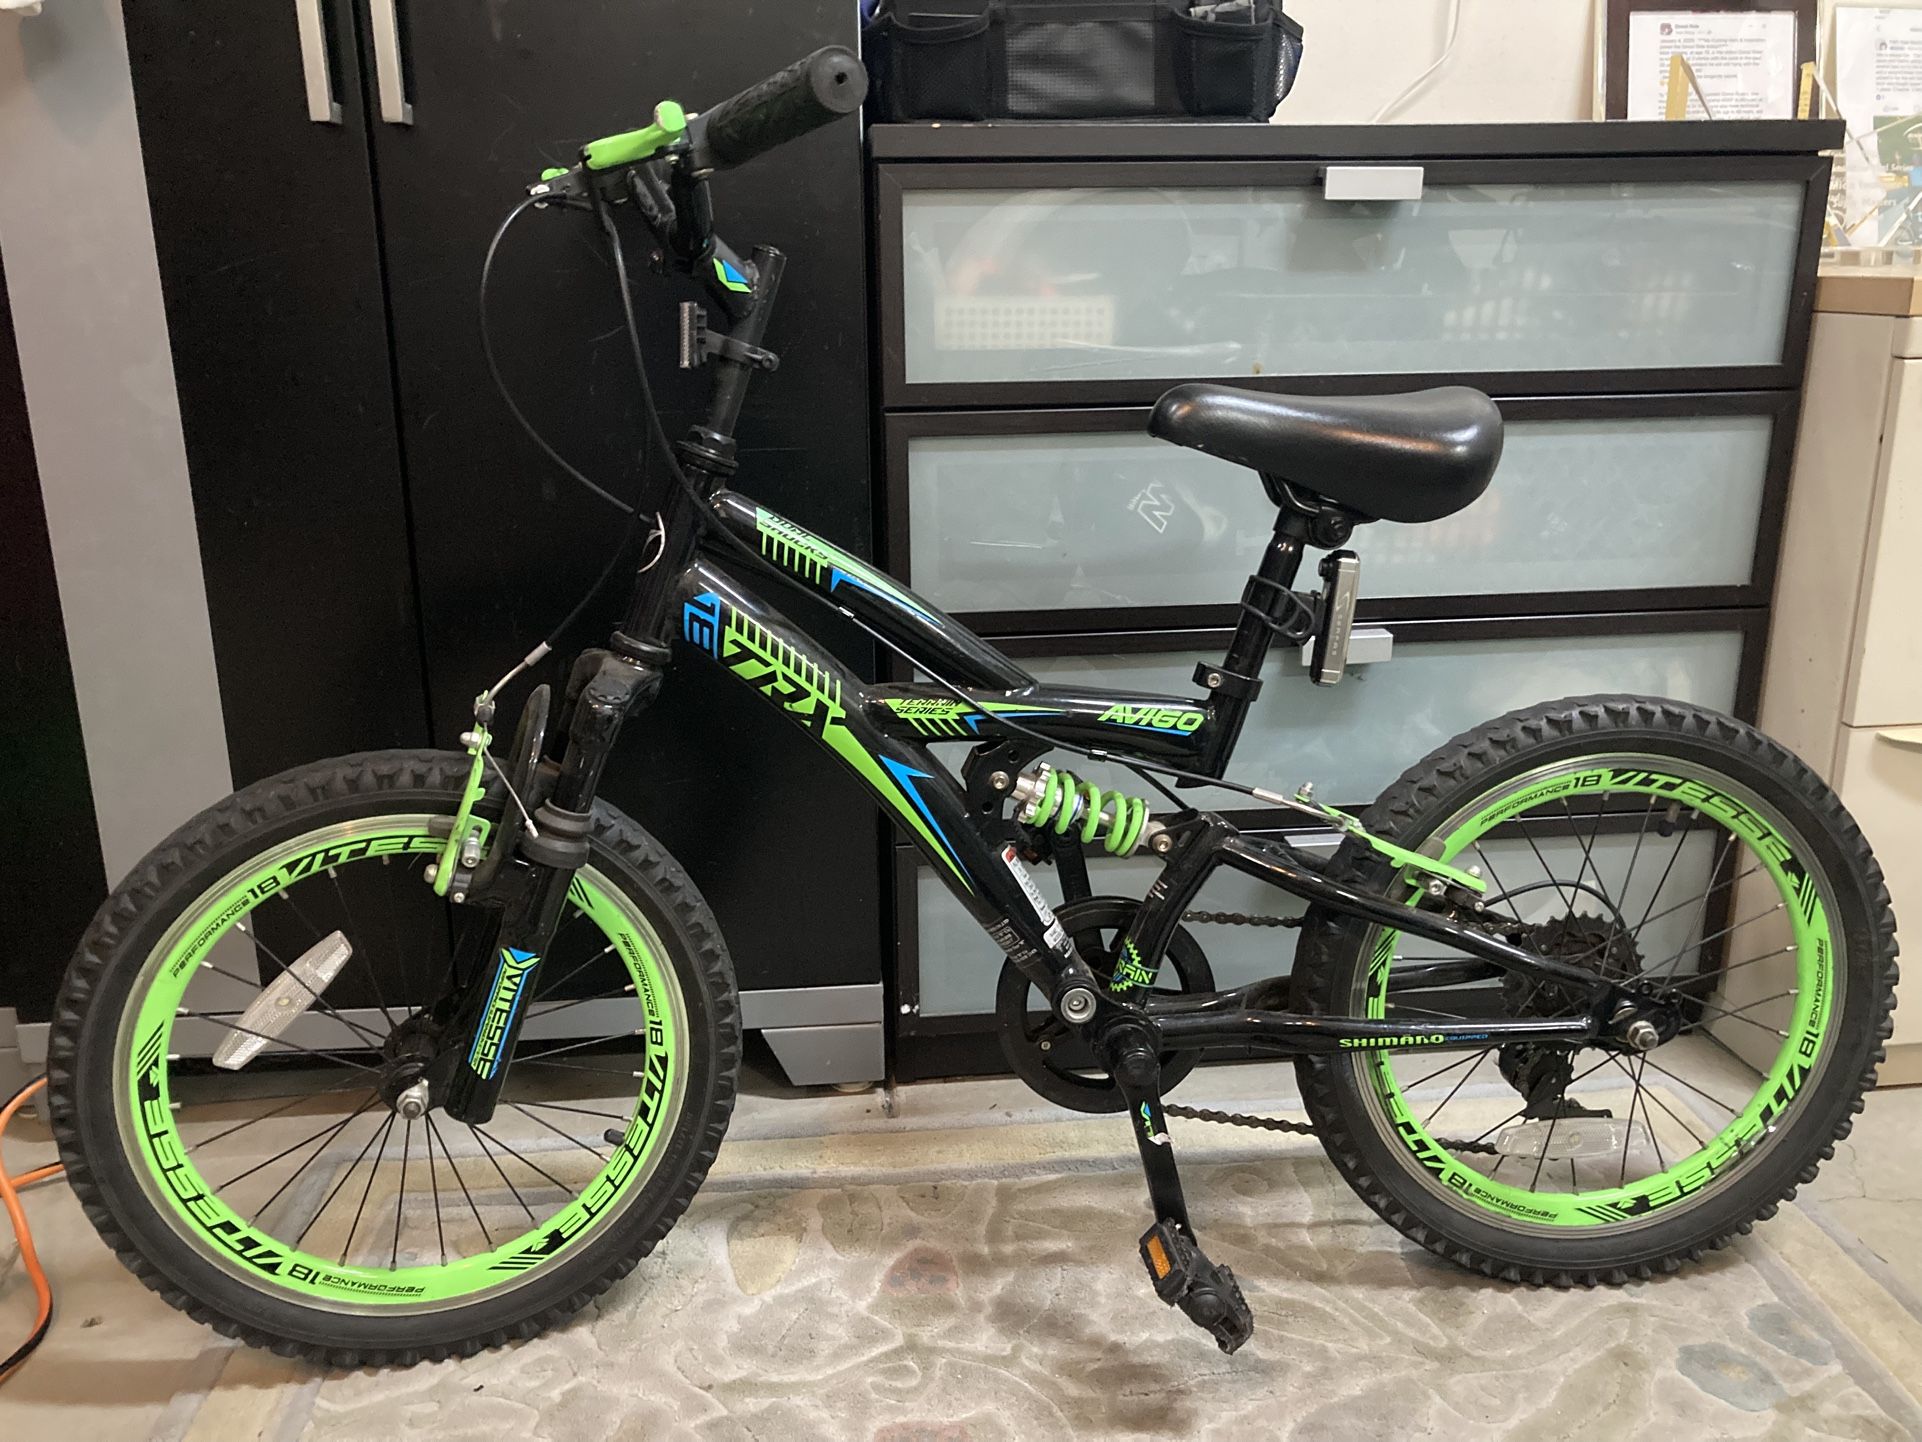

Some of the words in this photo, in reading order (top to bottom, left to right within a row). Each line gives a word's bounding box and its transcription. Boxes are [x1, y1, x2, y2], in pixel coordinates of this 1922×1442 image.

[895, 706, 953, 714] SERIES
[1097, 704, 1204, 731] AVIGO
[1479, 783, 1572, 826] PERFORMANCE
[1572, 773, 1599, 788] 18
[1605, 770, 1792, 866] VITESSE
[171, 896, 251, 978] PERFORMANCE
[245, 874, 282, 901] 18
[278, 835, 448, 882] VITES
[616, 931, 656, 1016] PERFORMANCE
[1808, 938, 1824, 1027] PERFORMANCE
[475, 971, 522, 1079] VITESSE
[648, 1018, 662, 1046] 18
[1339, 1034, 1444, 1047] SHIMANO
[1797, 1029, 1819, 1059] 18
[554, 1051, 667, 1240] VITESSE
[141, 1098, 286, 1276] VITESSE
[1446, 1170, 1473, 1193] 18
[1472, 1186, 1556, 1219] PERFORMANCE
[287, 1261, 321, 1285] 18
[321, 1273, 424, 1293] PERFORMANCE
